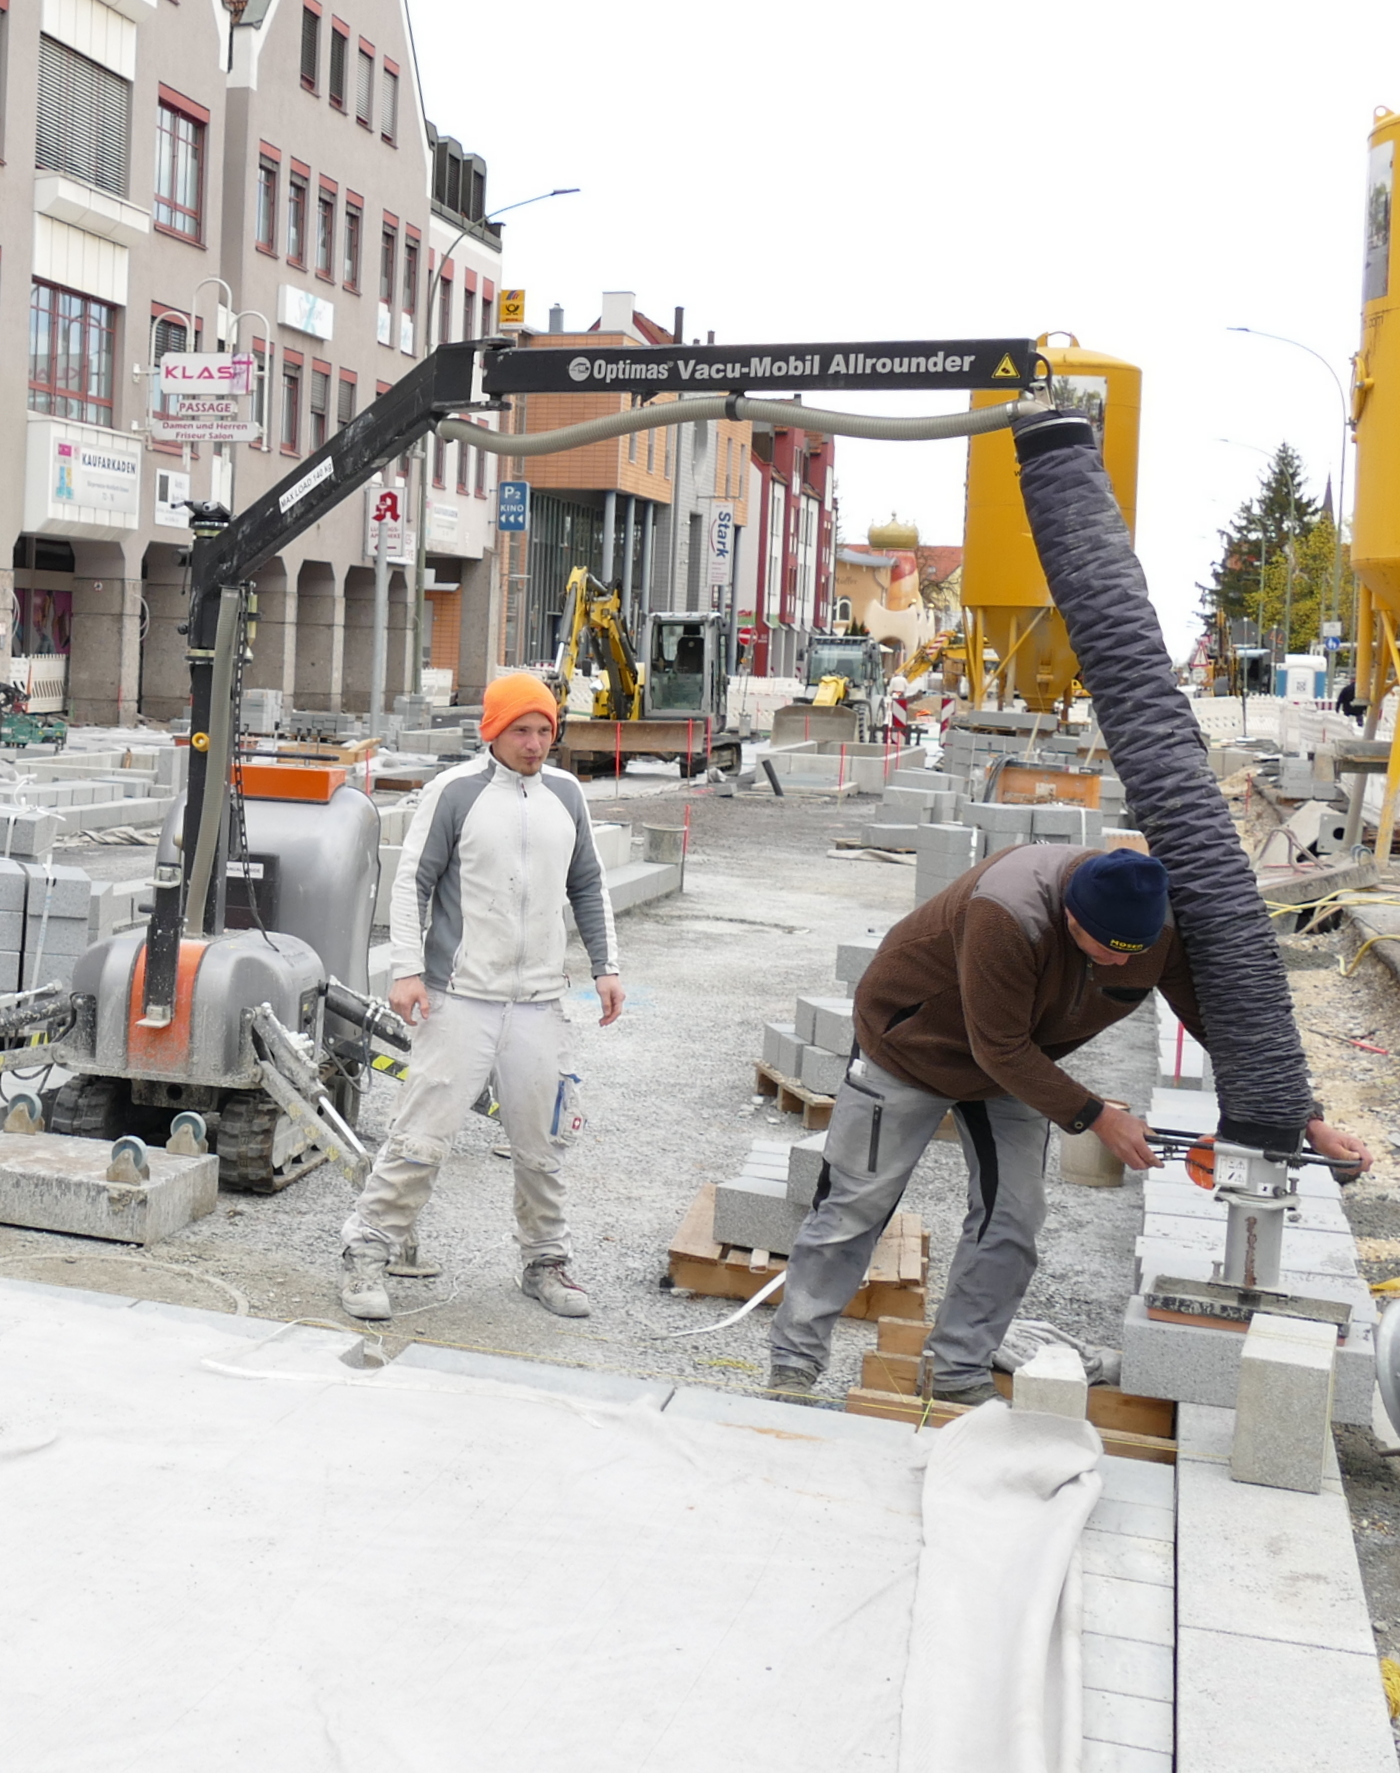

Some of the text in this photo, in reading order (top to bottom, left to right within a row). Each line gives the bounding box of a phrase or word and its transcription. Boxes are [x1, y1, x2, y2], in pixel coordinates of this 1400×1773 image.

[592, 351, 976, 383] Optimas Vacu-Mobil Allrounder
[179, 402, 232, 413] PASSAGE
[162, 421, 248, 430] Damen und Herren
[175, 431, 234, 440] Friseur Salon
[81, 452, 136, 475] KAUFARKADEN
[280, 493, 295, 508] MAX
[294, 478, 312, 497] LOAD
[500, 504, 525, 513] KINO
[716, 510, 732, 559] Stark
